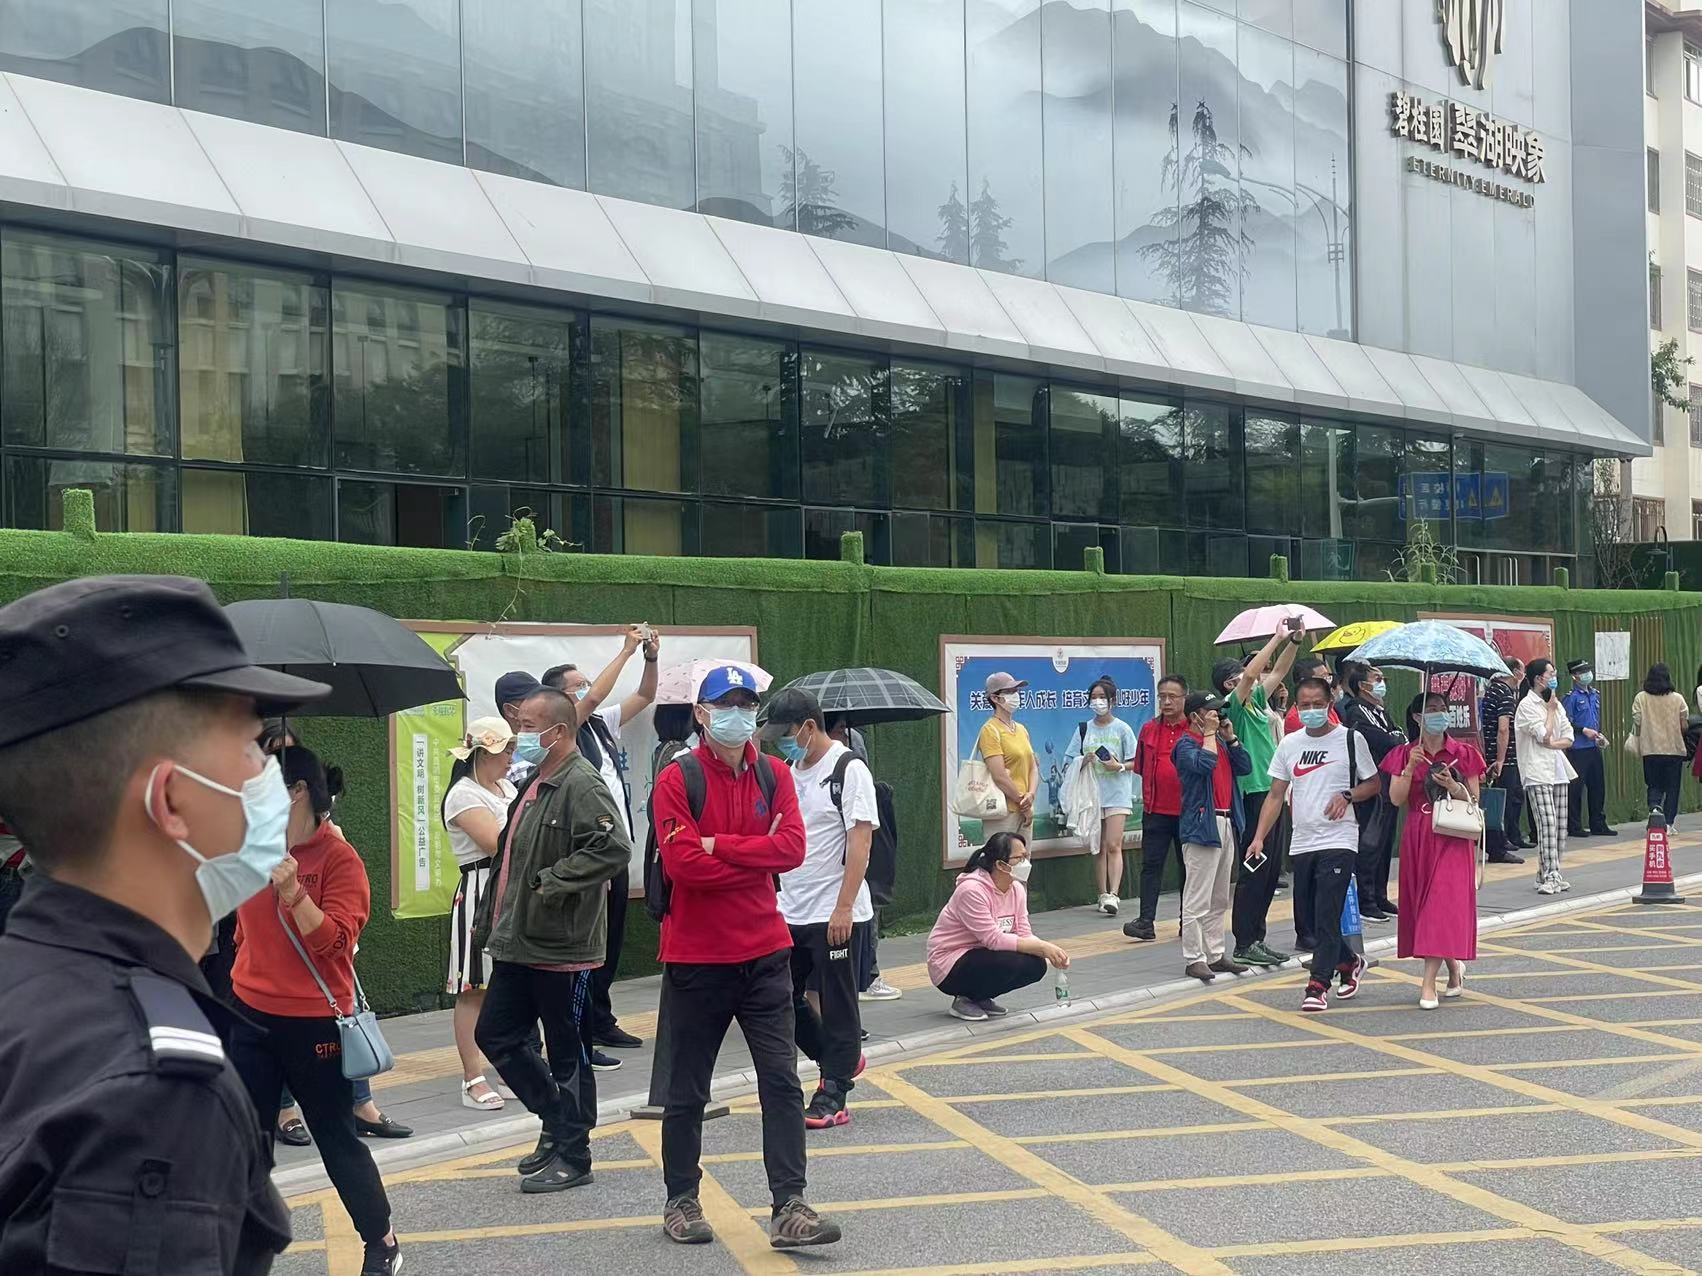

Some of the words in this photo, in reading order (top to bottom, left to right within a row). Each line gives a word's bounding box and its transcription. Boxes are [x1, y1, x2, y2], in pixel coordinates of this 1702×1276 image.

[1475, 178, 1536, 208] EMERALD
[727, 667, 743, 685] LA
[970, 690, 1057, 710] 关爱年人成长
[1299, 751, 1328, 765] NIKE
[830, 948, 848, 960] FIGHT
